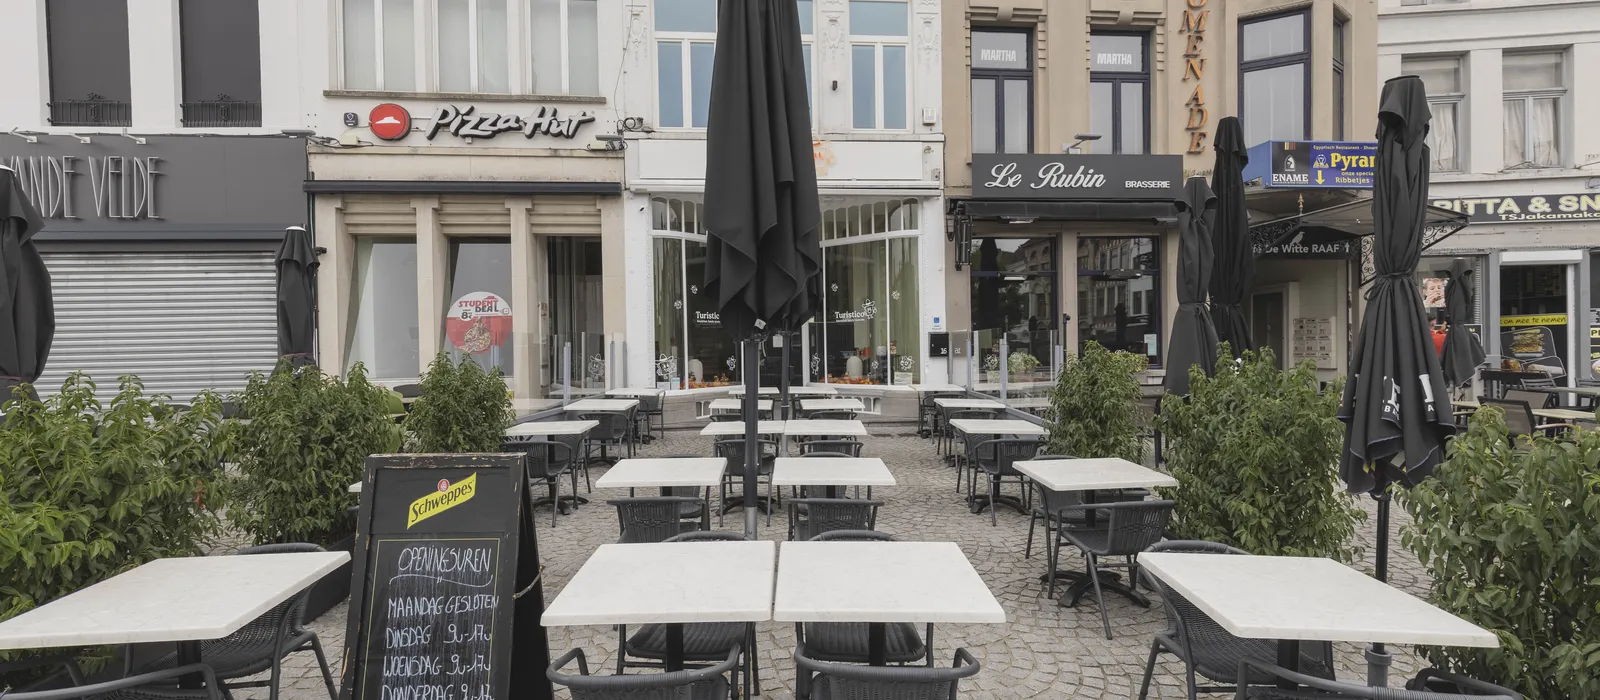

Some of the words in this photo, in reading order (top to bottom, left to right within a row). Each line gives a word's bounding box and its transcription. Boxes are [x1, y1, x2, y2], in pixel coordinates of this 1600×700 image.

[981, 49, 1017, 62] MARTHA
[1097, 53, 1133, 65] MARTHA
[425, 104, 521, 140] Pizza
[521, 105, 595, 139] Hut
[984, 162, 1022, 188] Le
[1030, 162, 1106, 189] Rubin
[1125, 180, 1171, 189] BRASSERIE
[1272, 173, 1309, 182] ENAME
[1335, 177, 1370, 185] Ribbetjes
[10, 156, 76, 217] ANDE
[88, 156, 160, 218] VELDE
[1528, 197, 1552, 213] &
[1282, 244, 1309, 253] Witte
[1312, 244, 1340, 253] RAAF
[458, 300, 499, 308] STUDENT
[834, 310, 865, 319] Turistico
[411, 481, 473, 523] Schweppes
[387, 596, 444, 619] MAANDAG
[445, 594, 500, 614] GESLOTEN
[386, 625, 432, 649] DINSDAG
[383, 655, 443, 678] WOENSDAG
[381, 684, 454, 700] DONDERDAG
